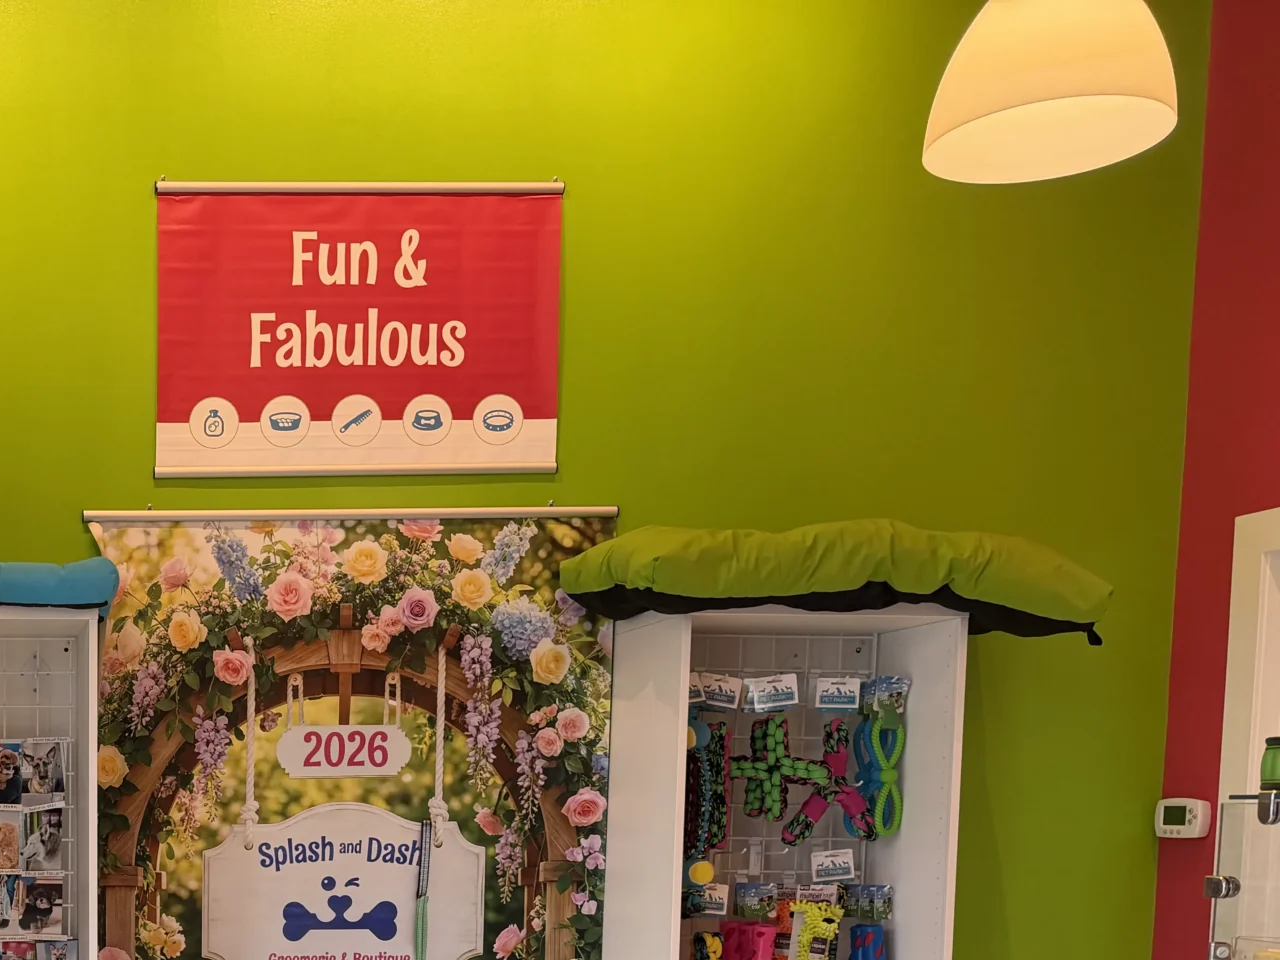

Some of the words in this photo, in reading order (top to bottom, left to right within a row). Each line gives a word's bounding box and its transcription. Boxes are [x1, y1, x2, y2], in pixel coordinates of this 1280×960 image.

[292, 231, 378, 286] Fun
[394, 228, 428, 289] &
[249, 308, 467, 368] Fabulous
[303, 730, 389, 768] 2026
[258, 836, 334, 872] Splash
[339, 840, 362, 854] and
[366, 837, 421, 867] Dash
